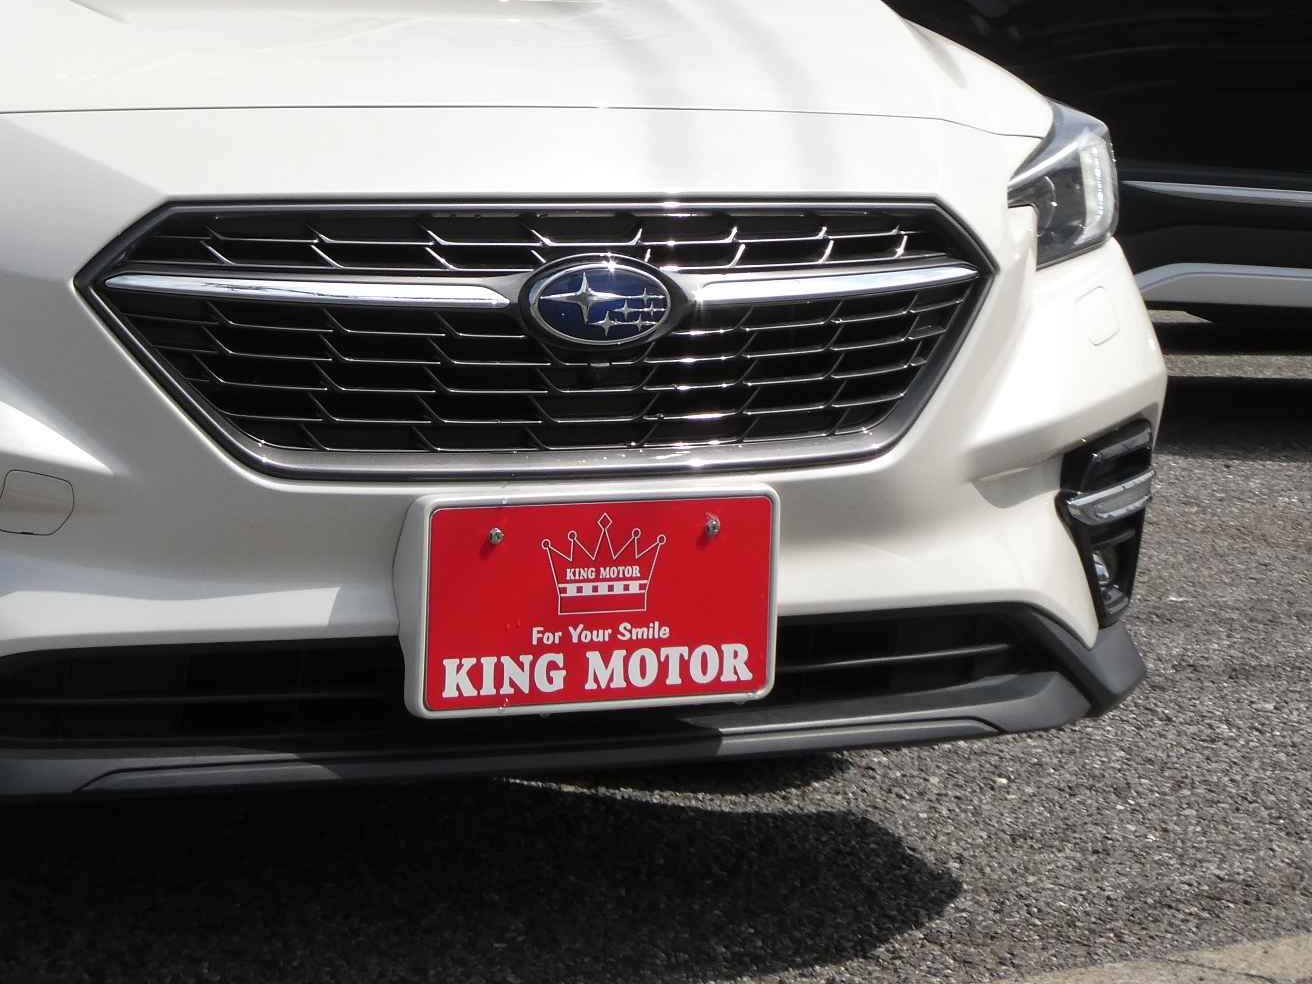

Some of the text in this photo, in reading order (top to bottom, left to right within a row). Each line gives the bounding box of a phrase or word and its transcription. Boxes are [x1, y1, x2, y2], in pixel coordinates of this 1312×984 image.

[565, 565, 641, 581] KING MOTOR
[532, 621, 670, 646] For Your Smile
[441, 643, 753, 699] KING MOTOR
